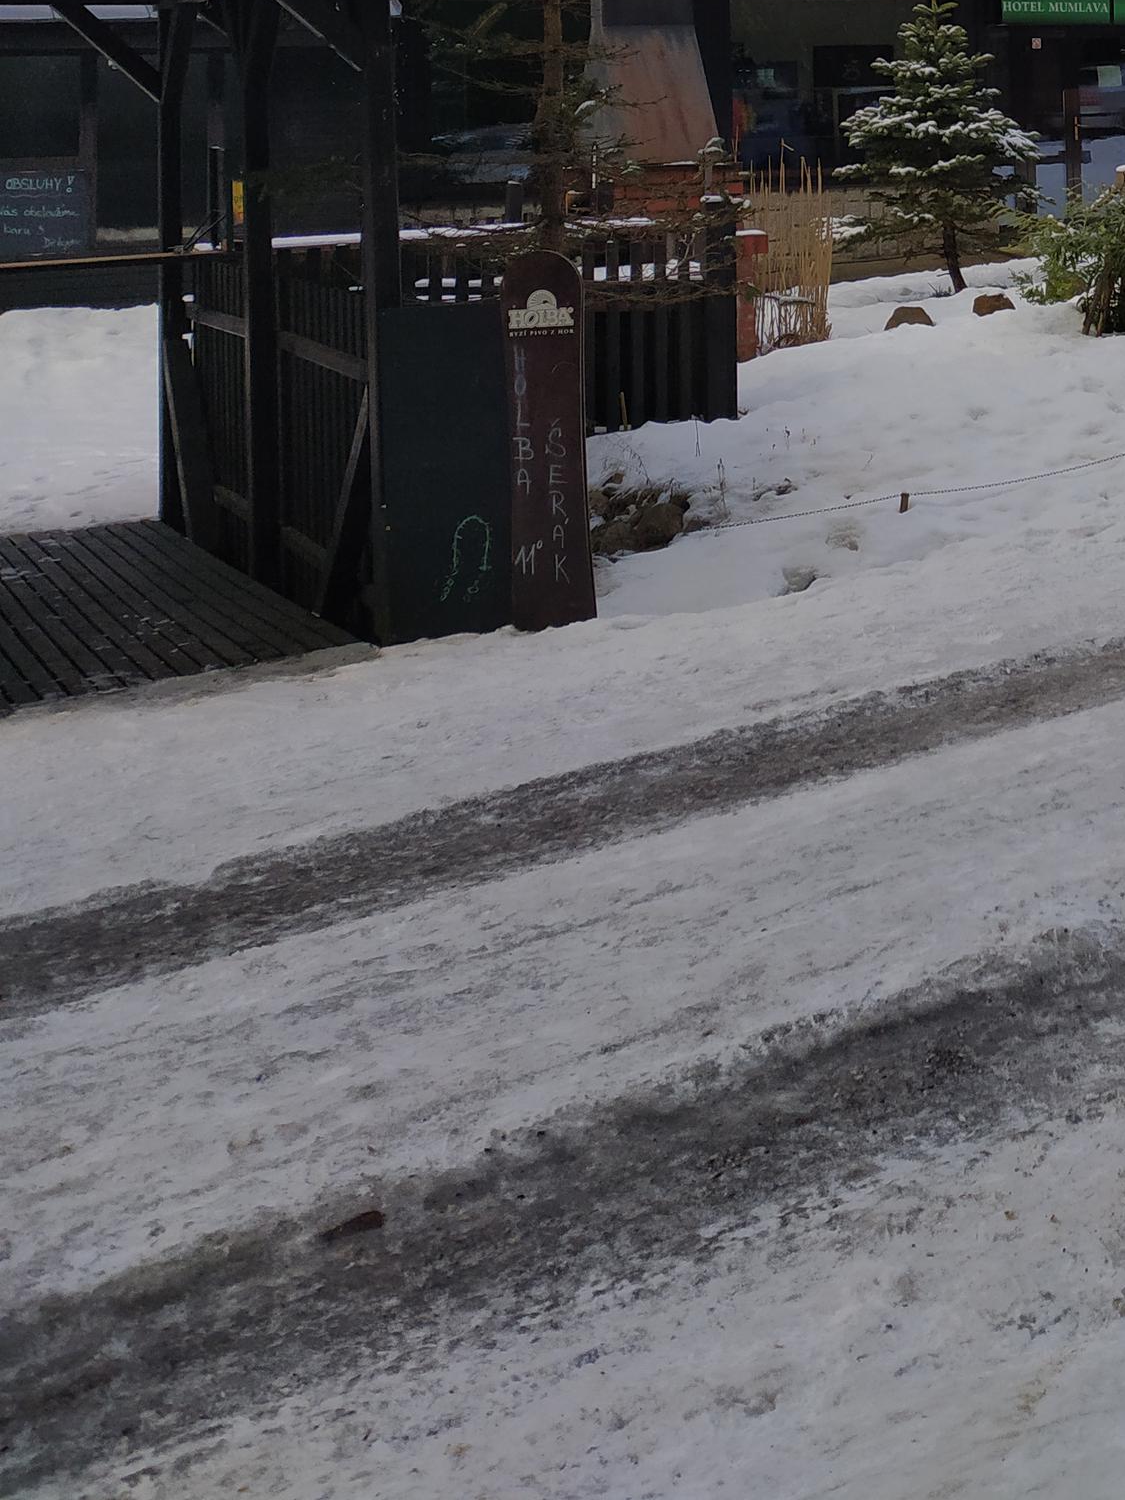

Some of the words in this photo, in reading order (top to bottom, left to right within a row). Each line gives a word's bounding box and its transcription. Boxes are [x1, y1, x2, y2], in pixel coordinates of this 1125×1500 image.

[1002, 1, 1045, 12] HOTEL
[1049, 2, 1109, 13] MUMLAVA
[5, 177, 62, 191] OBSLUHY
[508, 307, 575, 329] HOLBA
[512, 344, 534, 496] HOLBA
